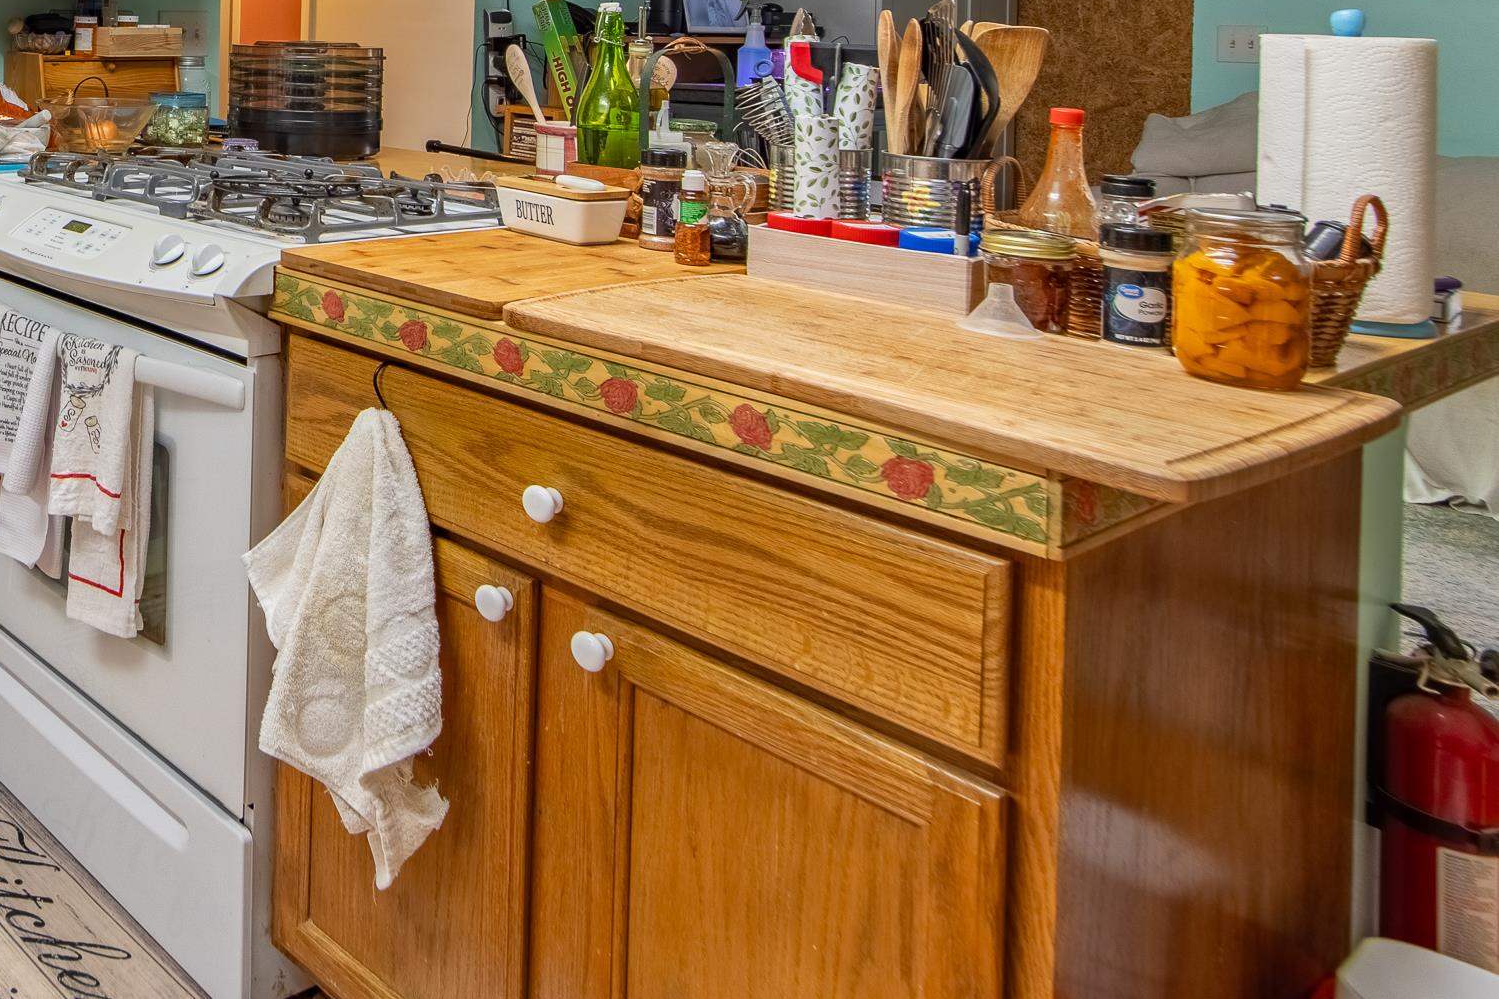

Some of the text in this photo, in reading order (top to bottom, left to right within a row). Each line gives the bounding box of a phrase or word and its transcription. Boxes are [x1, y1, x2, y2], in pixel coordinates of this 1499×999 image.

[553, 56, 571, 93] HIGH
[516, 200, 555, 226] BUTTER
[1139, 301, 1164, 309] Garlic
[65, 338, 105, 351] Kitchen
